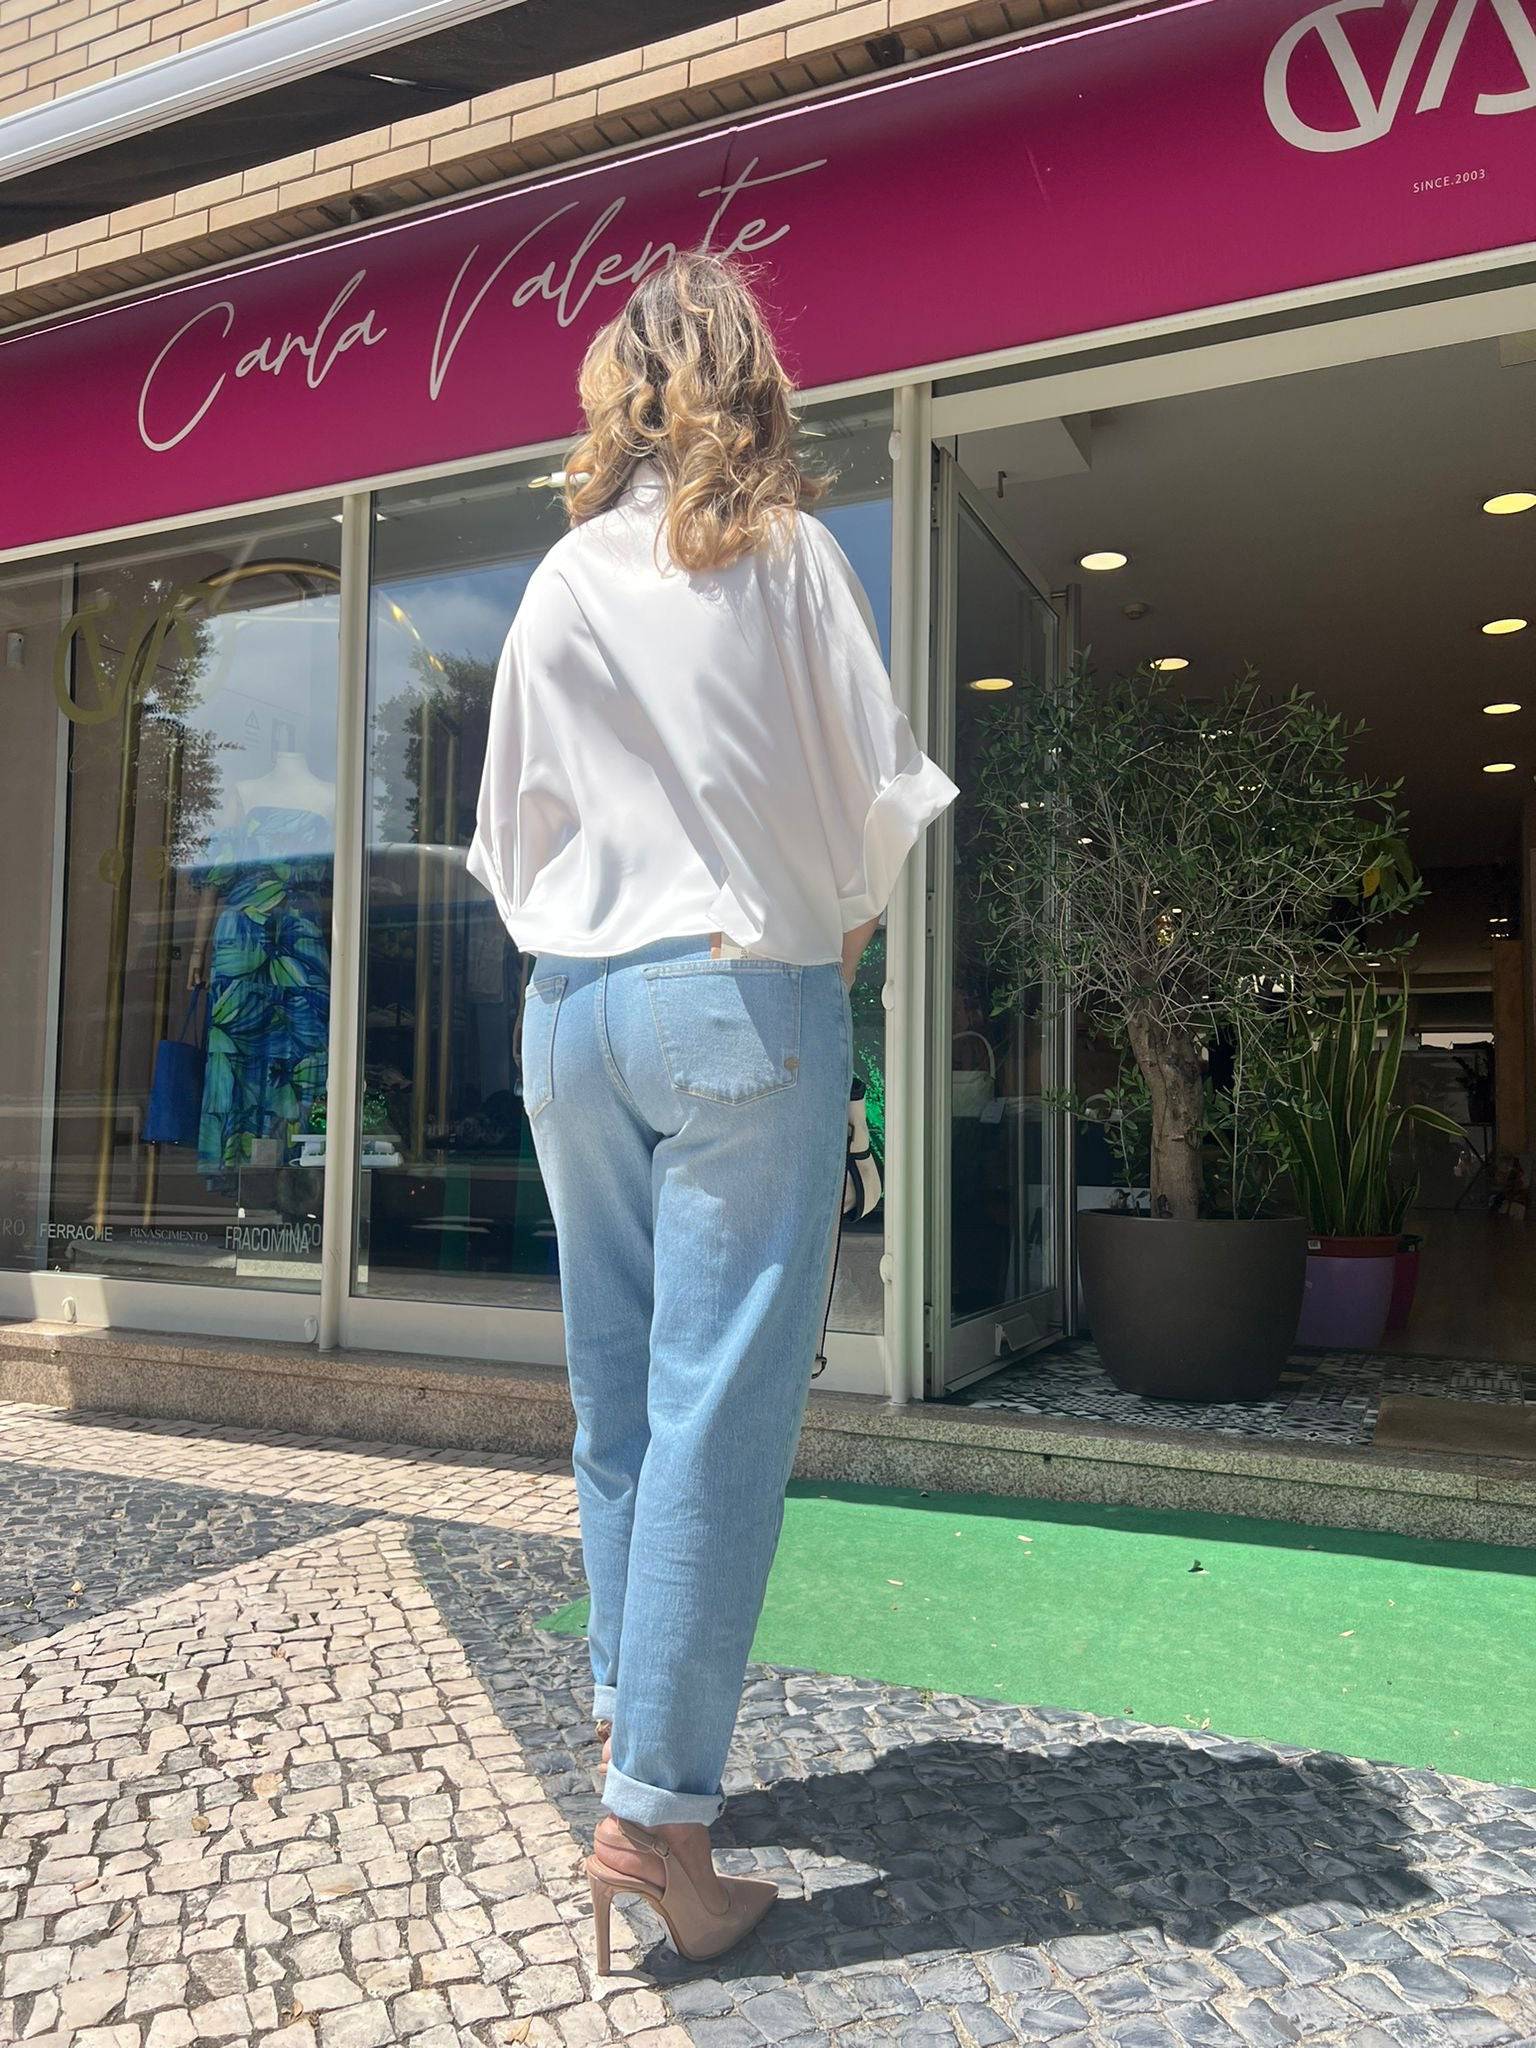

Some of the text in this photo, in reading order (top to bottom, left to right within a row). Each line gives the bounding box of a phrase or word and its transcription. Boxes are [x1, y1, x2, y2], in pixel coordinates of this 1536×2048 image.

[1412, 167, 1487, 194] SINCE.2003
[137, 156, 829, 452] Carla Valente
[39, 1222, 114, 1242] FERRACHE
[129, 1226, 209, 1242] RINASCIMENTO
[224, 1225, 310, 1254] FRACOMINA
